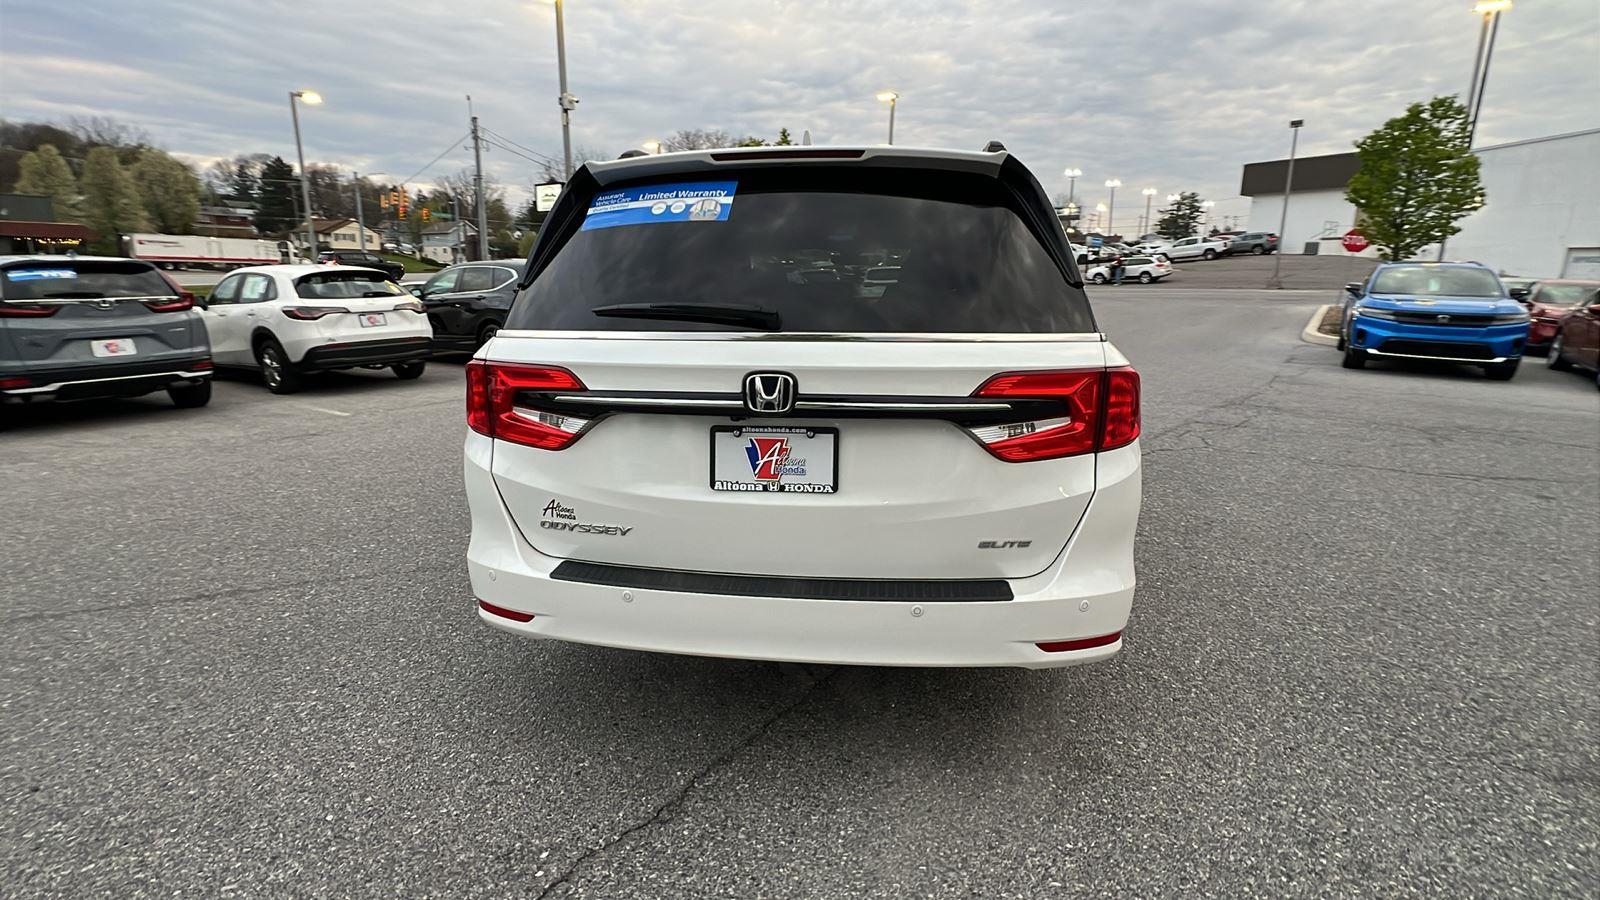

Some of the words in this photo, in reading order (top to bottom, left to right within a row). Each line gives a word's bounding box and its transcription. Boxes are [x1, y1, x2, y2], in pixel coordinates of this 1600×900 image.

[597, 193, 625, 202] Assurant
[638, 190, 676, 201] Limited
[677, 189, 727, 199] Warranty
[742, 426, 807, 434] altoonahonda.com
[714, 481, 764, 491] Altoona
[784, 483, 834, 493] HONDA
[540, 520, 633, 537] ODYSSEY
[978, 540, 1033, 549] ELITE
